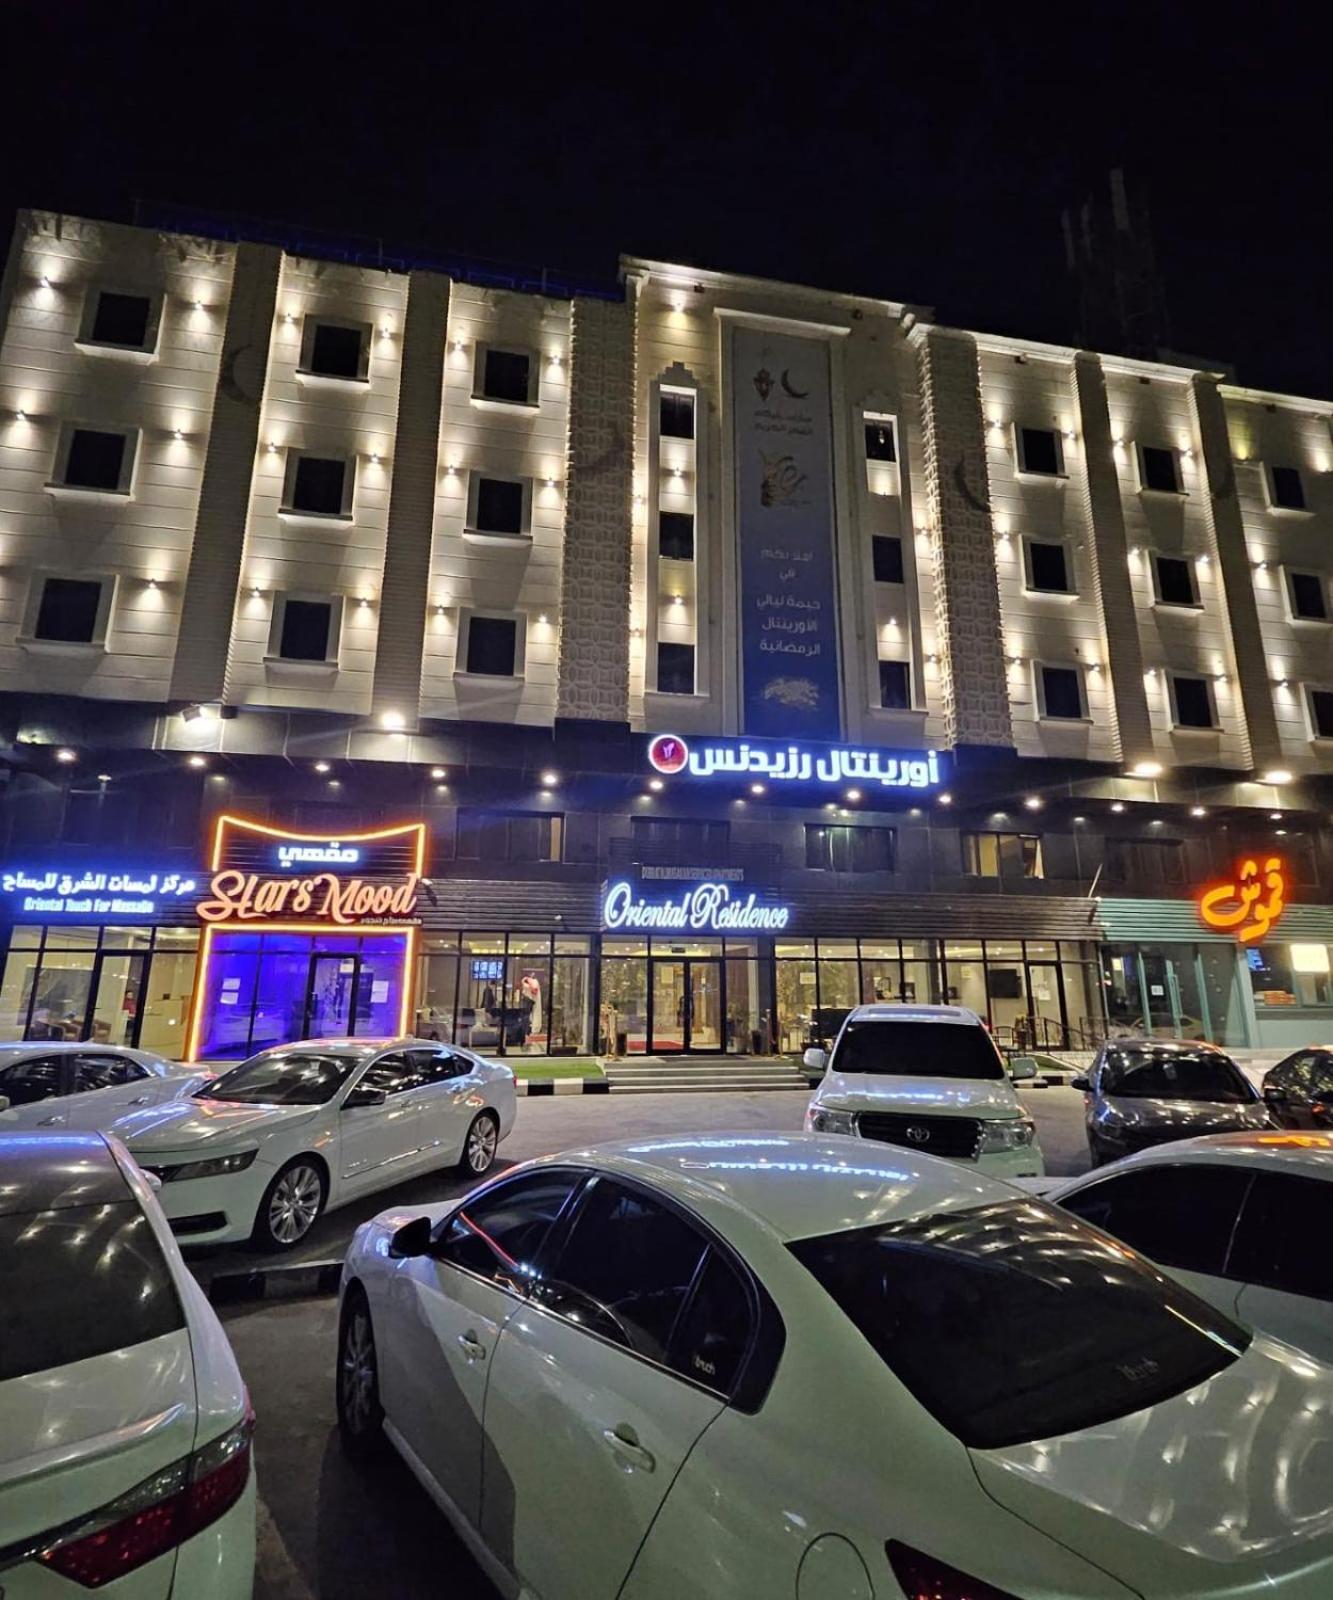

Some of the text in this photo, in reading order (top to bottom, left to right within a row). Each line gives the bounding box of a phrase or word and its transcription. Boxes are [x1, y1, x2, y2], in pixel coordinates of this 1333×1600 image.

[688, 744, 940, 788] أورينتال رزيدنس
[57, 871, 107, 895] الشرق
[107, 874, 158, 894] لمسات
[159, 874, 196, 895] مركز
[313, 872, 417, 924] Mood
[604, 882, 789, 929] Oriental Residence
